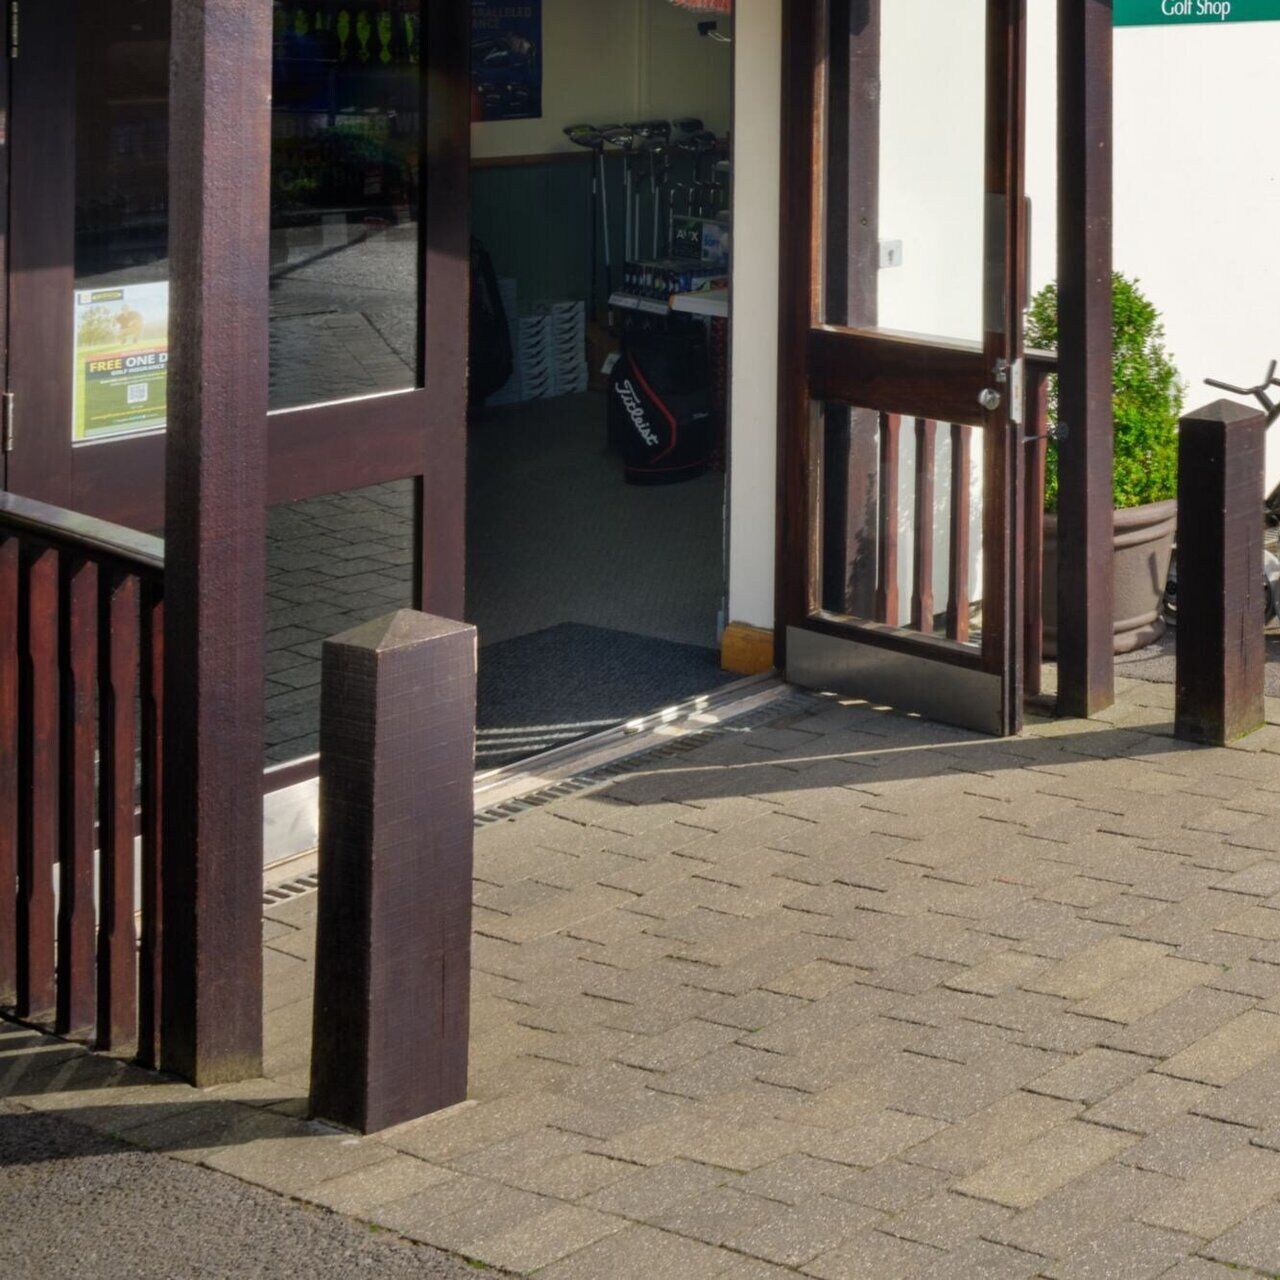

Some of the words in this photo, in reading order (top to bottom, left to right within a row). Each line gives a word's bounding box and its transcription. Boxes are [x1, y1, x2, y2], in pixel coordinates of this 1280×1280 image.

[90, 359, 122, 372] FREE
[126, 354, 156, 367] ONE
[614, 378, 660, 447] Titleist
